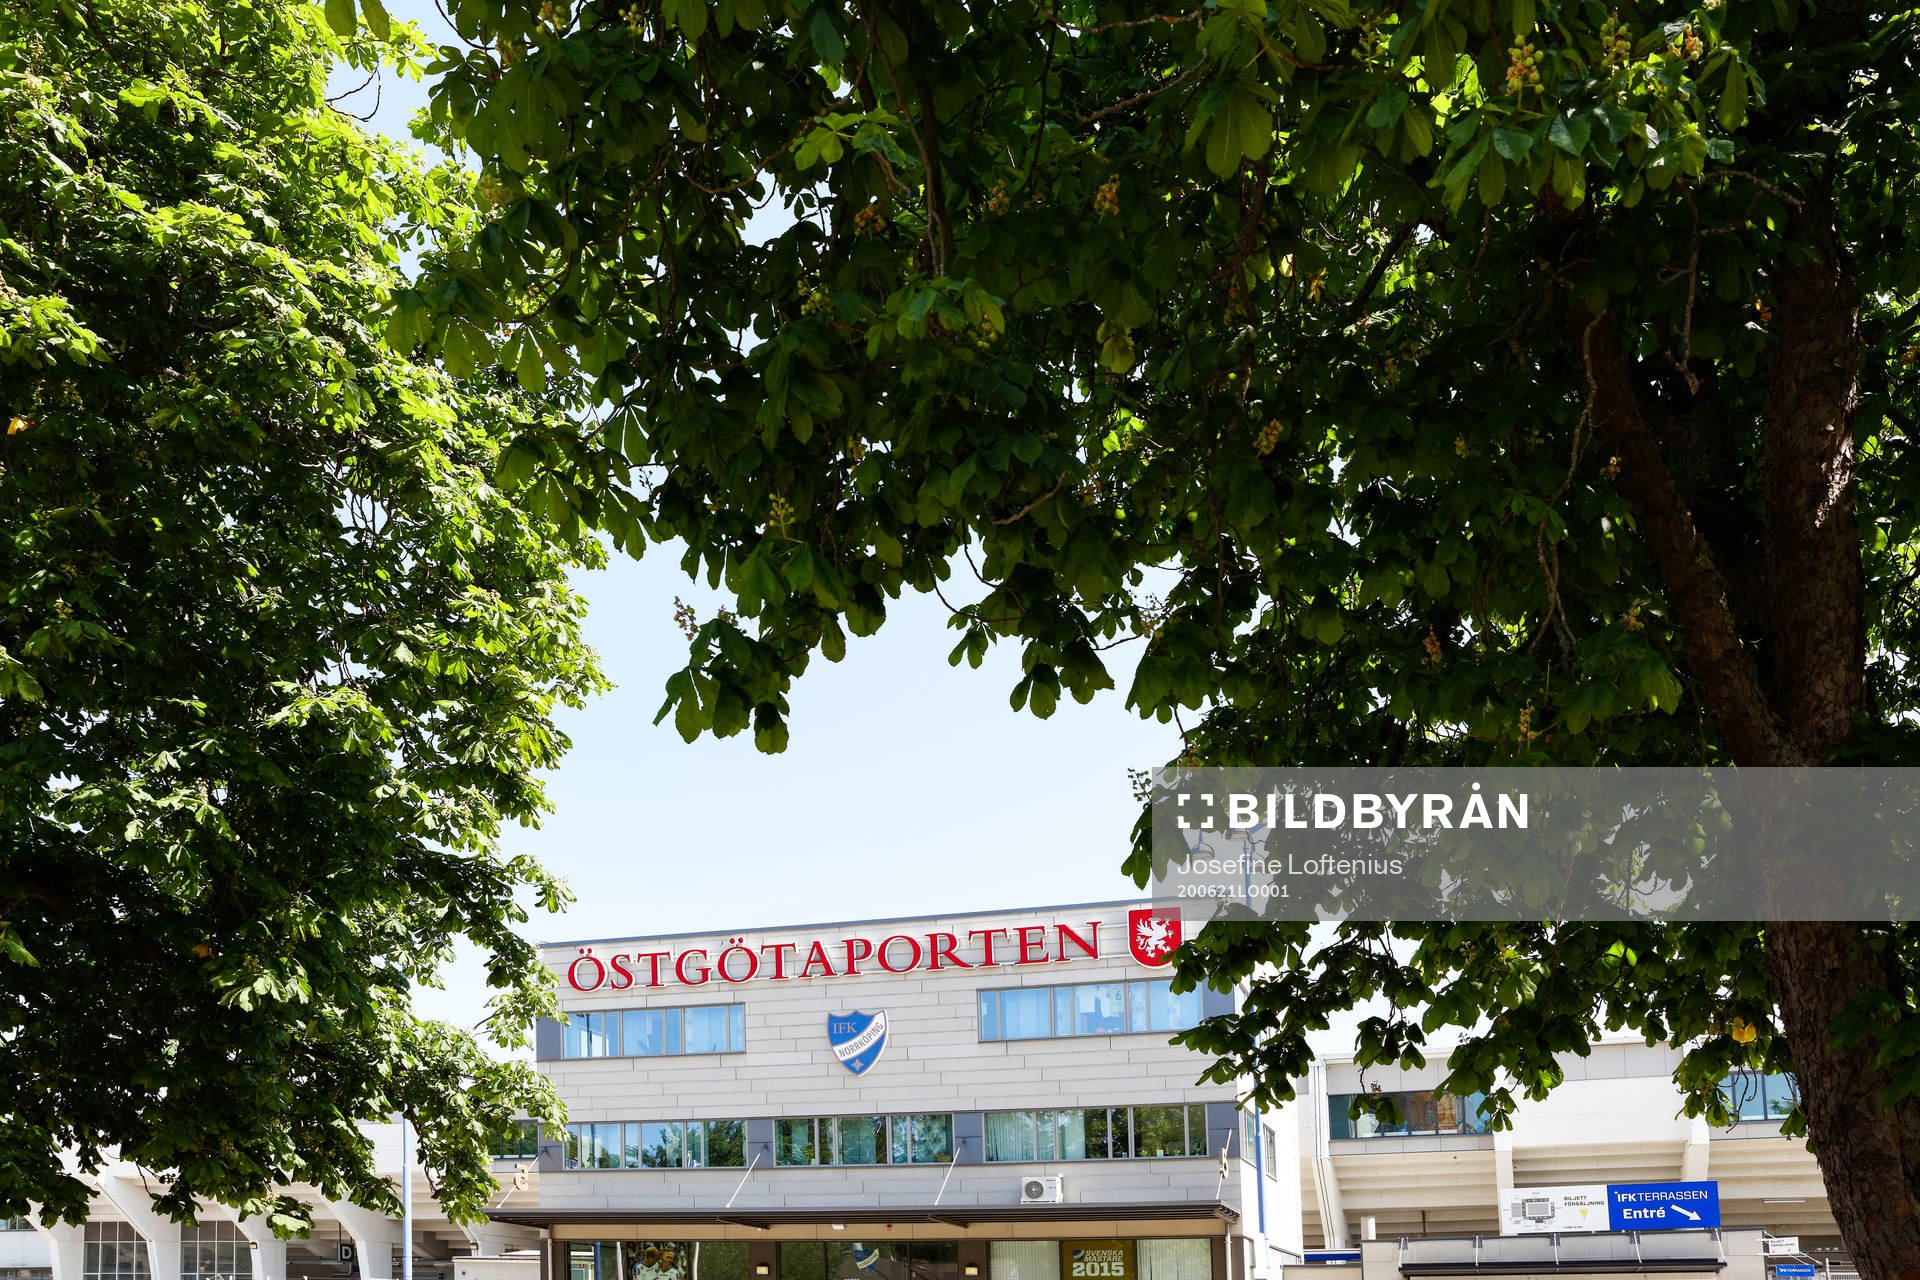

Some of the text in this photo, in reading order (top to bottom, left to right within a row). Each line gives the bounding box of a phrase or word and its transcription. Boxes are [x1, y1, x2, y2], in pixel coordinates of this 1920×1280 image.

[567, 921, 1102, 992] ÖSTGÖTAPORTEN
[833, 1022, 857, 1034] IFK
[838, 1022, 884, 1058] NORRKÖPING
[1623, 1207, 1666, 1219] Entré
[341, 1246, 352, 1259] D
[1072, 1262, 1125, 1276] 2015
